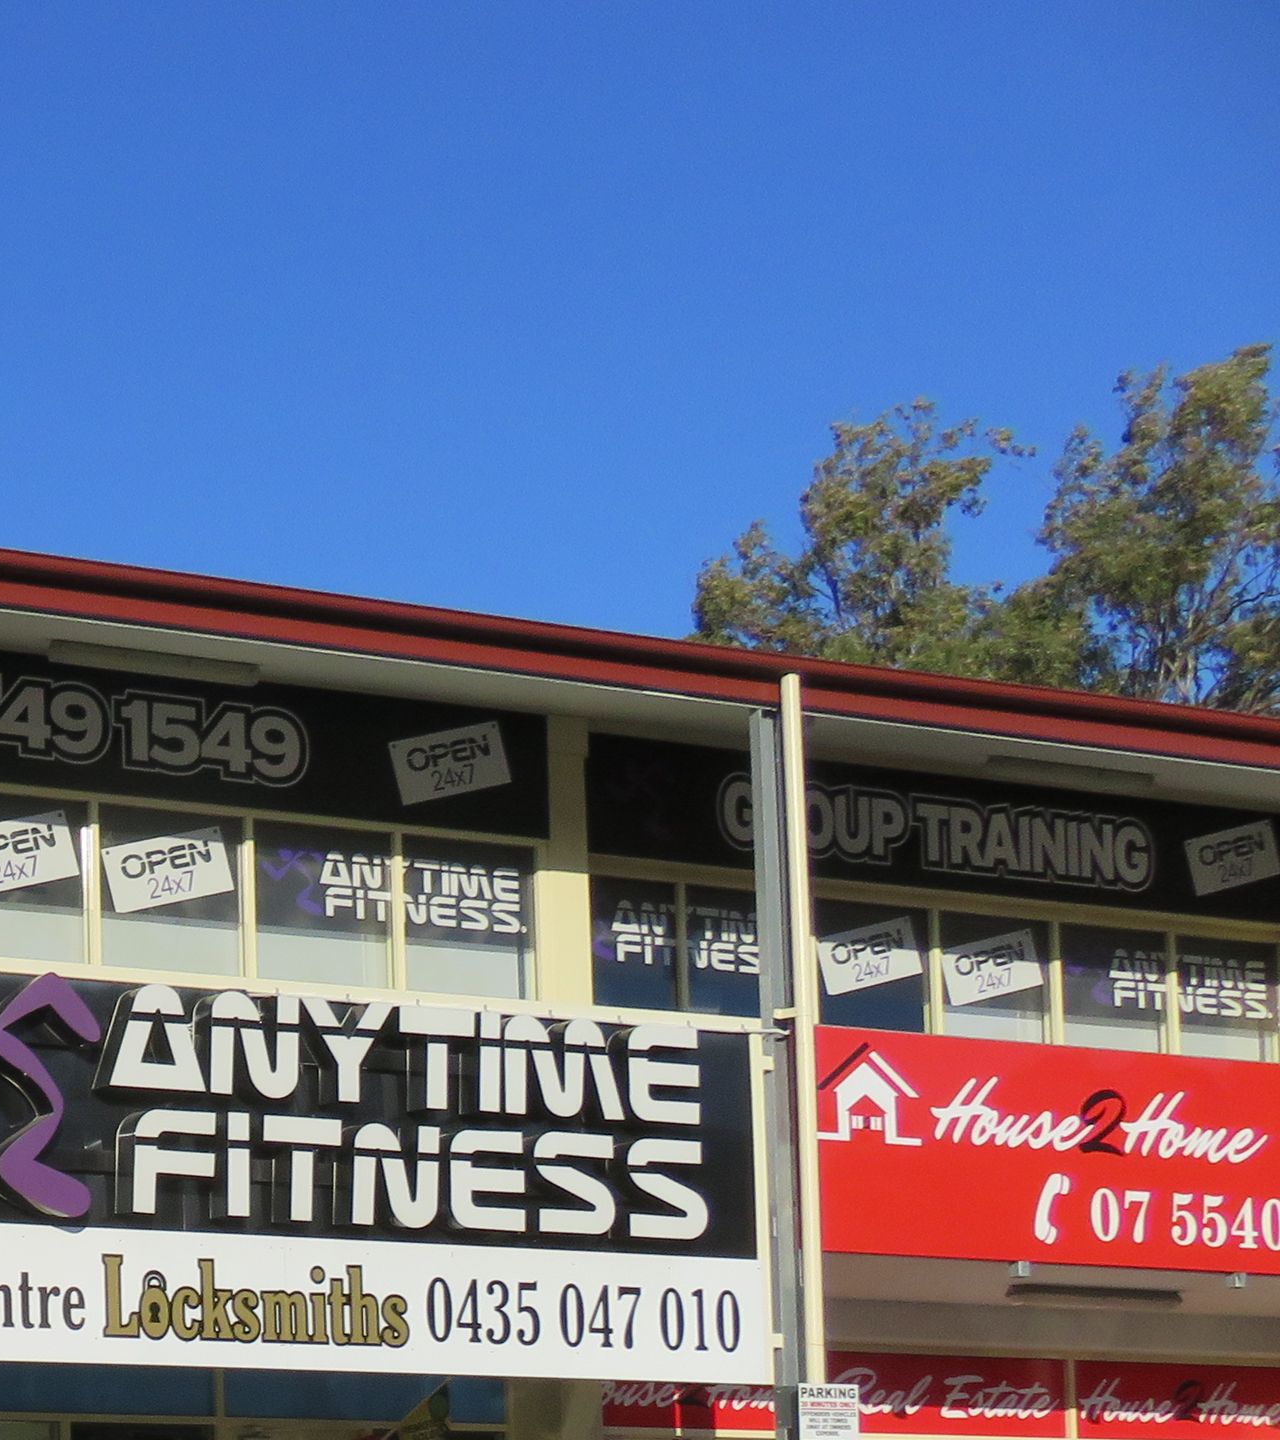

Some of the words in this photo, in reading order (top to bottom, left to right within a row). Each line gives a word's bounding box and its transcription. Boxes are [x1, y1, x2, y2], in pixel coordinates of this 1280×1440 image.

[119, 695, 305, 781] 1549
[406, 734, 490, 771] OPEN
[431, 764, 475, 791] 24x7
[721, 778, 907, 860] GOUP
[913, 799, 1150, 887] TRAINING
[1199, 832, 1265, 866] OPEN
[120, 840, 212, 879] OPEN
[146, 871, 195, 899] 24x7
[616, 933, 760, 974] FITNES
[831, 929, 905, 965] OPEN
[955, 940, 1025, 975] OPEN
[852, 956, 890, 982] 24x7
[975, 967, 1012, 993] 24x7
[100, 984, 702, 1126] ANYTIME
[128, 1109, 711, 1240] FITNESS
[1089, 1188, 1151, 1243] 07
[102, 1251, 410, 1348] Locksmiths
[425, 1276, 542, 1348] 0435
[557, 1282, 642, 1350] 047
[659, 1287, 741, 1353] 010
[800, 1387, 856, 1399] PARKING
[939, 1374, 1058, 1420] Estate
